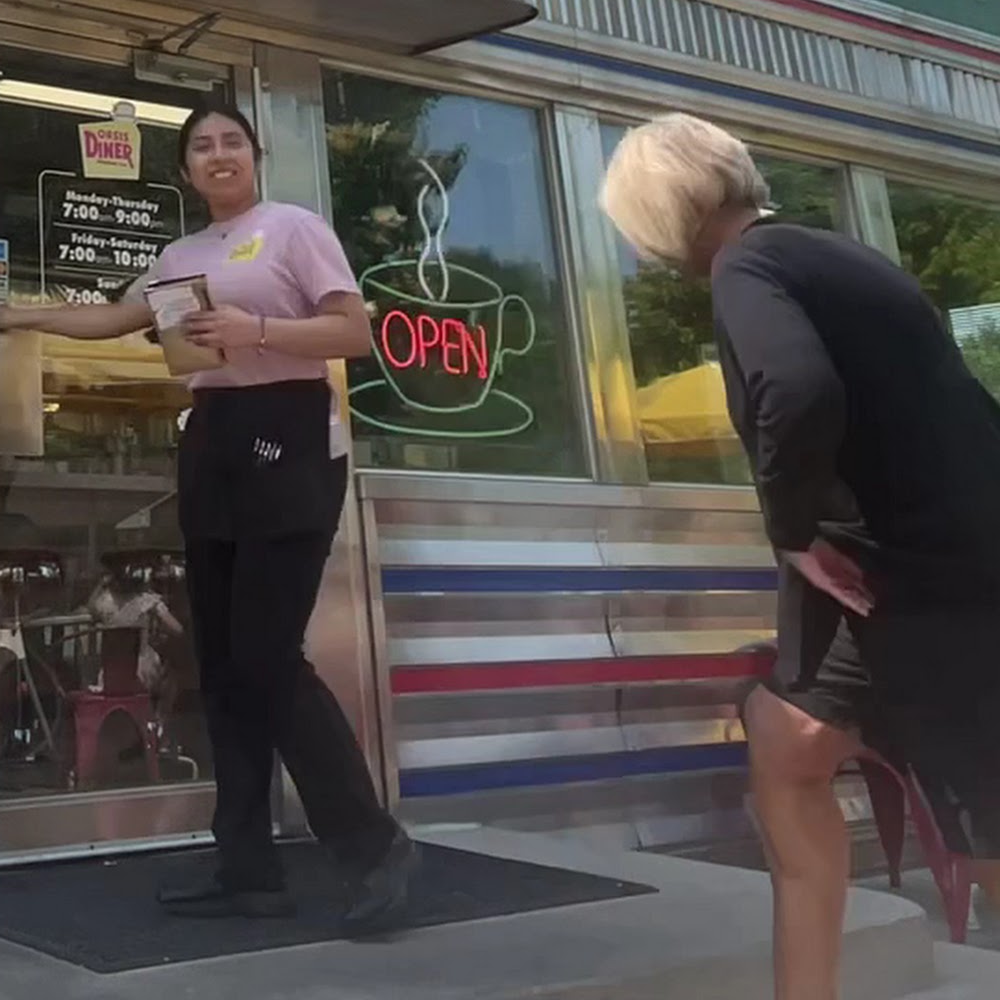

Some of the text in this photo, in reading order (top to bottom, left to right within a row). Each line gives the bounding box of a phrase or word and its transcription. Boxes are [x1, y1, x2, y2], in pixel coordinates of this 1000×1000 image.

[97, 129, 129, 141] OASIS
[71, 233, 158, 253] Friday-Saturday
[381, 310, 488, 379] OPEN
